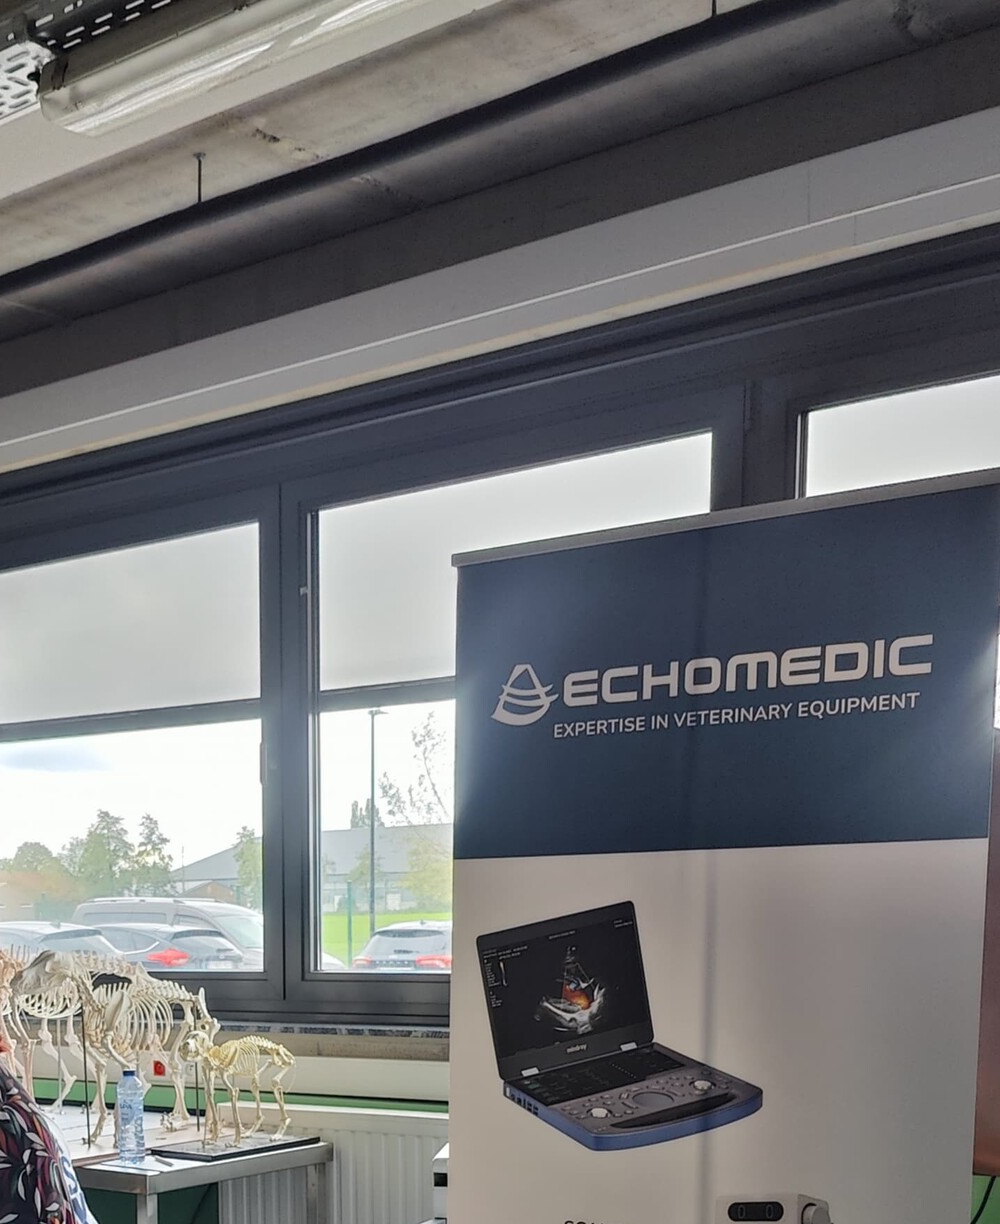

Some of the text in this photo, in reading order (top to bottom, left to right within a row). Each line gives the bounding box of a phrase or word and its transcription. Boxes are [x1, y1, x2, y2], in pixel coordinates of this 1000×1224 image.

[563, 633, 934, 707] ECHOMEDIC
[554, 691, 920, 738] EXPERTISE IN VETERINARY EQUIPMENT
